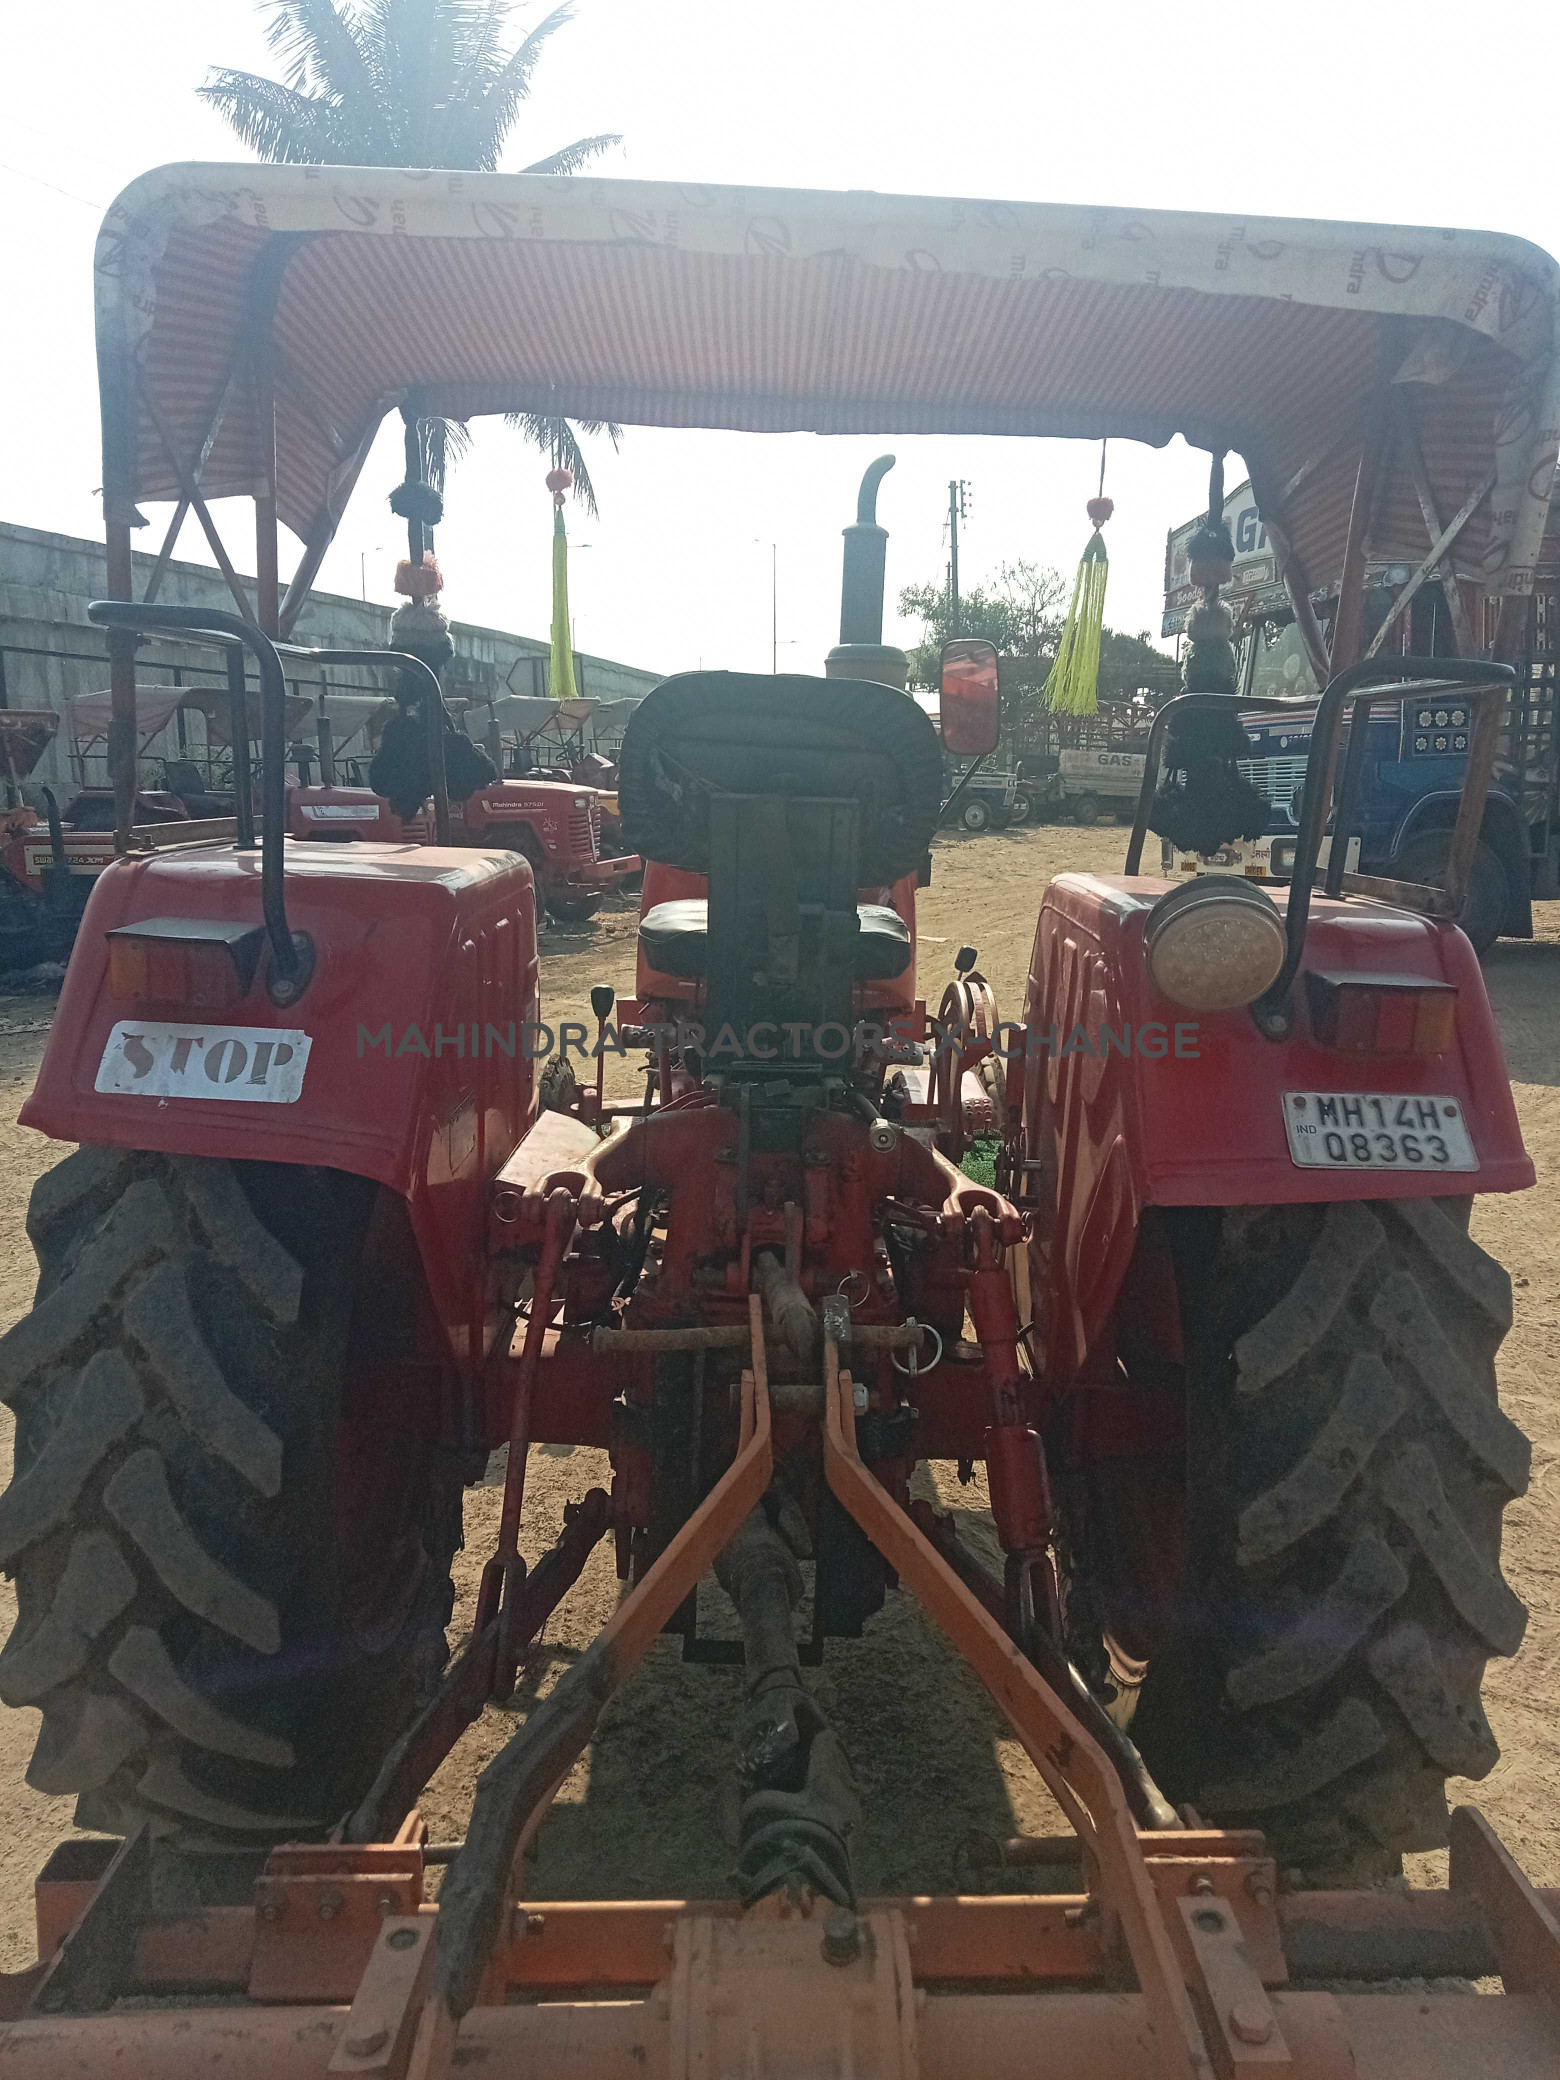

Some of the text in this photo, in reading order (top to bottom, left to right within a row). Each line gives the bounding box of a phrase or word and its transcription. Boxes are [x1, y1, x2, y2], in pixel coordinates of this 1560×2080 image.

[1098, 754, 1132, 767] GAS
[121, 1031, 294, 1085] STOP
[1296, 1124, 1317, 1135] IND
